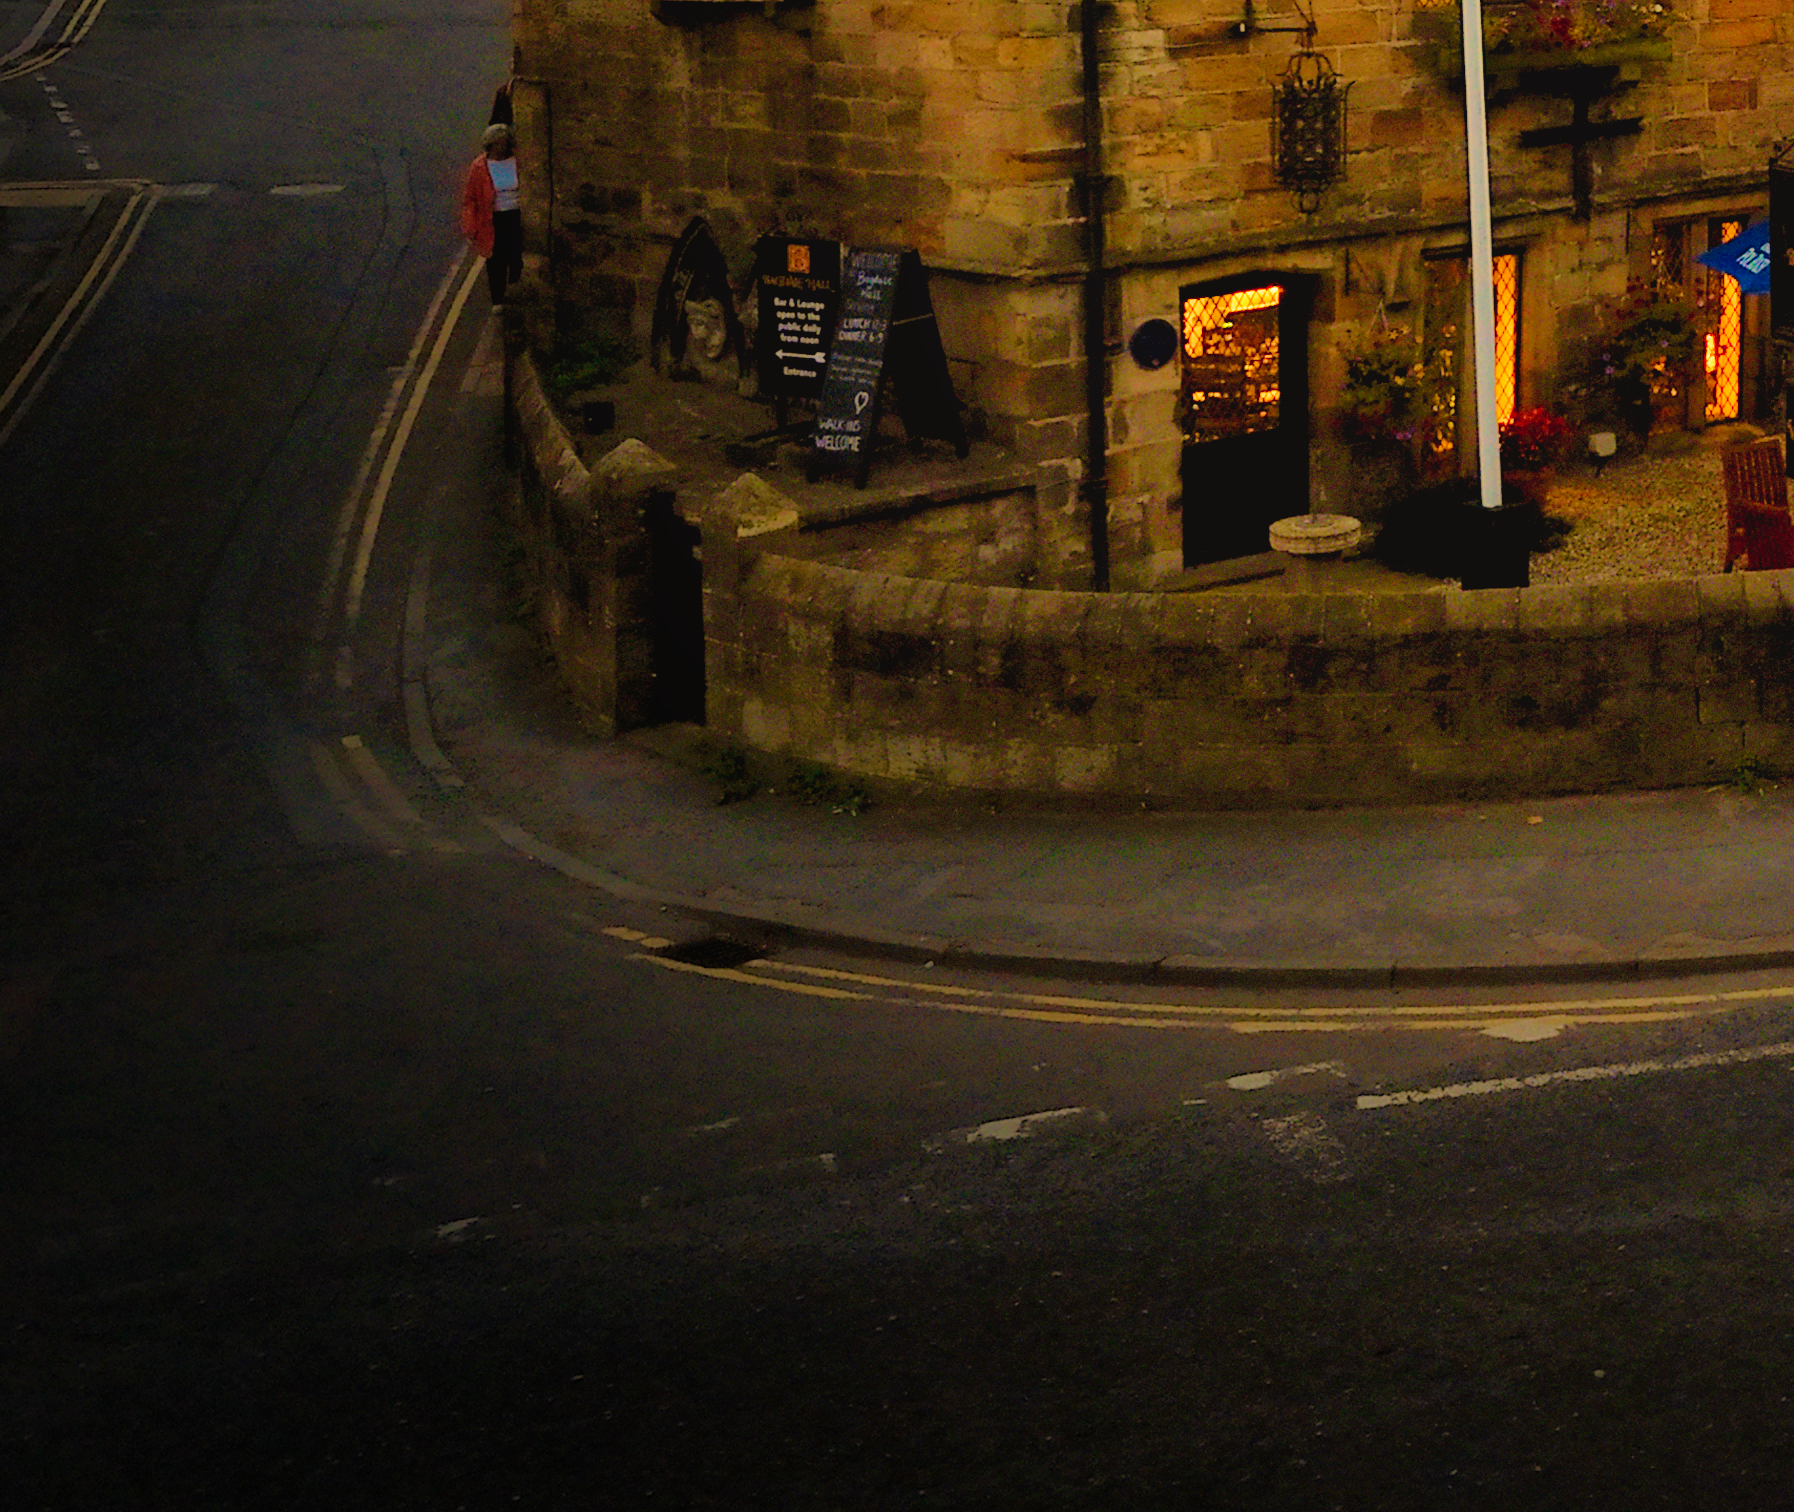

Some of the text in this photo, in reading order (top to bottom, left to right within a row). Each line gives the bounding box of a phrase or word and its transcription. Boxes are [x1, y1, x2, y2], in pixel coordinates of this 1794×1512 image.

[774, 296, 825, 311] Bar & Lounge
[776, 311, 821, 321] open to the
[778, 322, 822, 335] public daily
[843, 318, 870, 330] LUNCH
[780, 332, 820, 344] from noon
[783, 366, 817, 378] Entrance
[815, 435, 862, 452] WELCOME
